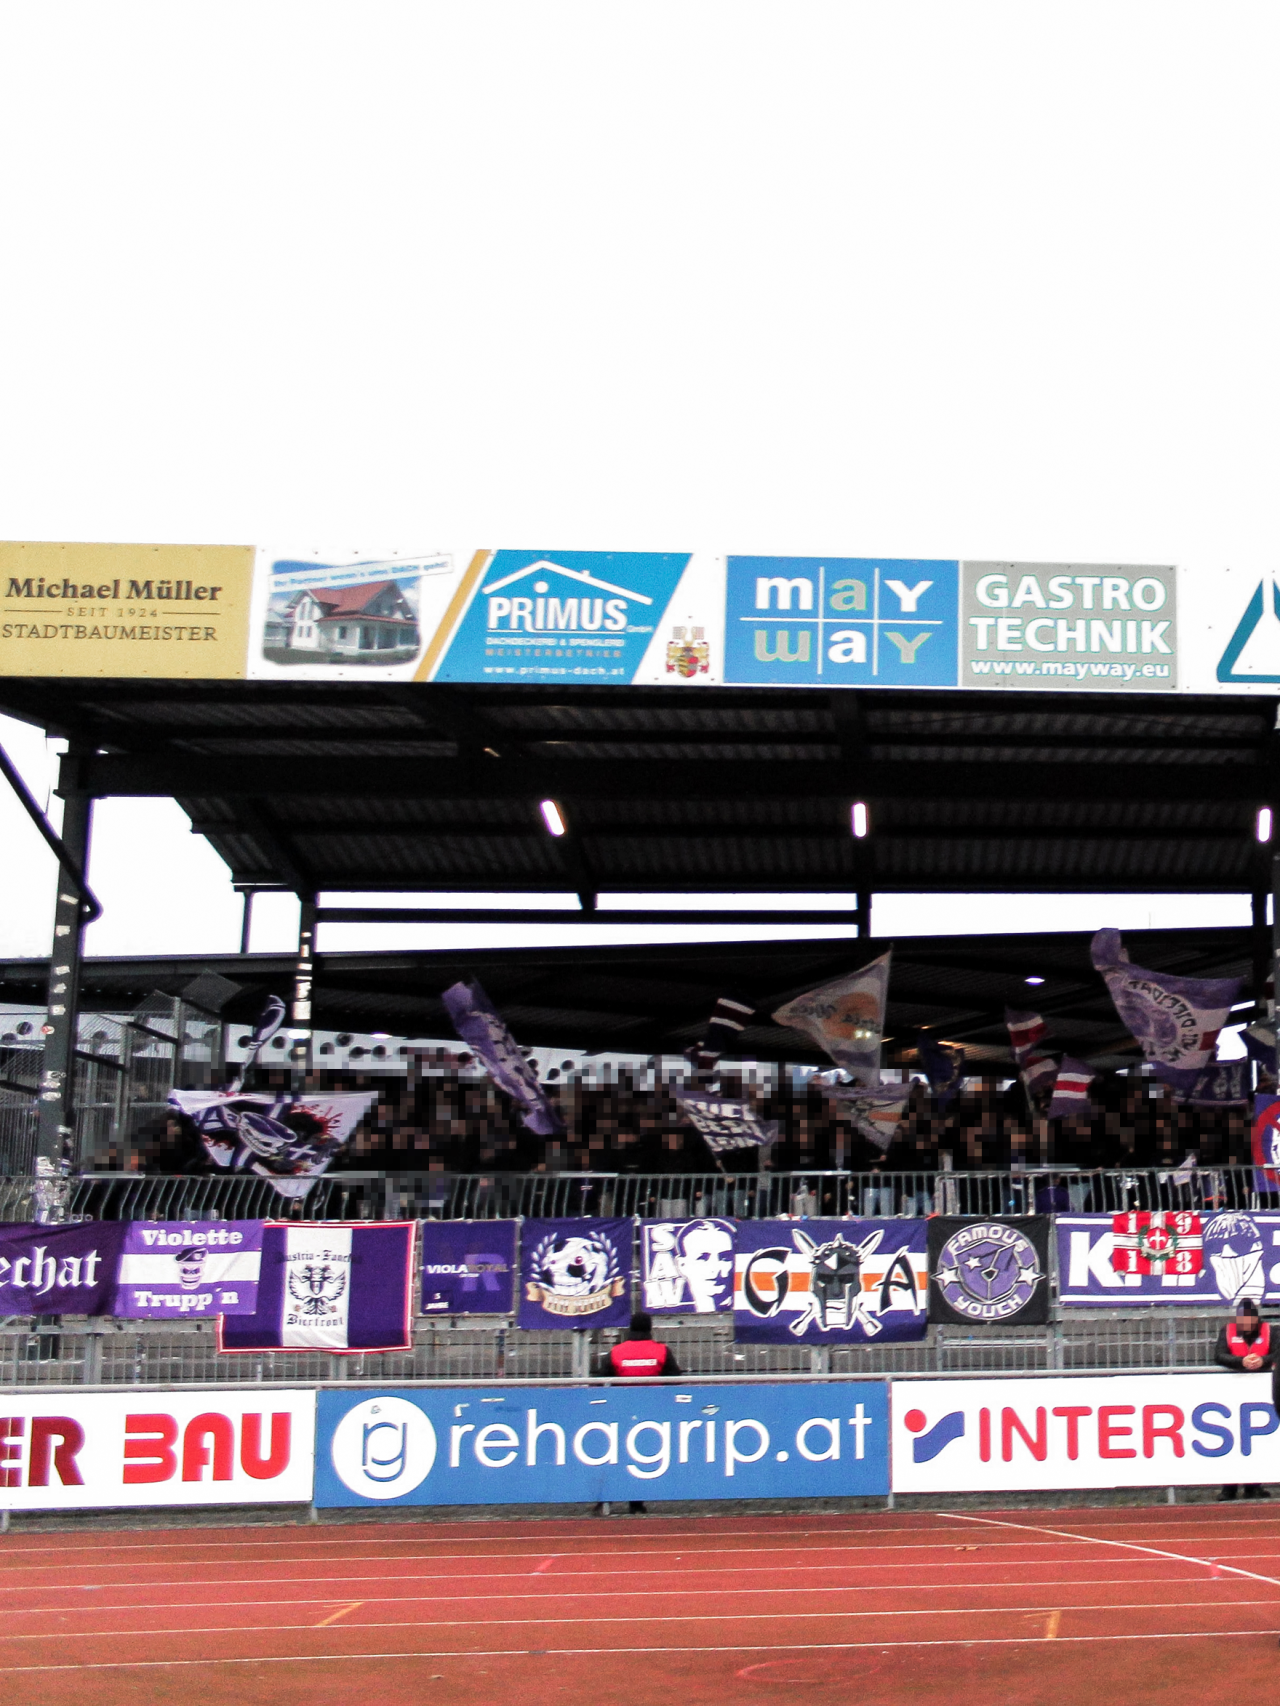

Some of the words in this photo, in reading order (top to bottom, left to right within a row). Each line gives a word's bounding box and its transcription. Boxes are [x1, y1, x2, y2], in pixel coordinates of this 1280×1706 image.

[5, 577, 120, 599] Michael
[126, 579, 222, 601] Müller
[975, 573, 1166, 611] GASTRO
[67, 607, 108, 617] SEIT
[118, 608, 158, 618] 1924
[2, 624, 218, 642] STADTBAUMEISTER
[969, 616, 1173, 654] TECHNIK
[971, 658, 1169, 681] www.mayway.eu
[142, 1228, 243, 1247] Violette
[947, 1226, 1030, 1256] FAMOUS
[123, 1411, 292, 1484] BAU
[450, 1403, 872, 1479] rehagrip.at
